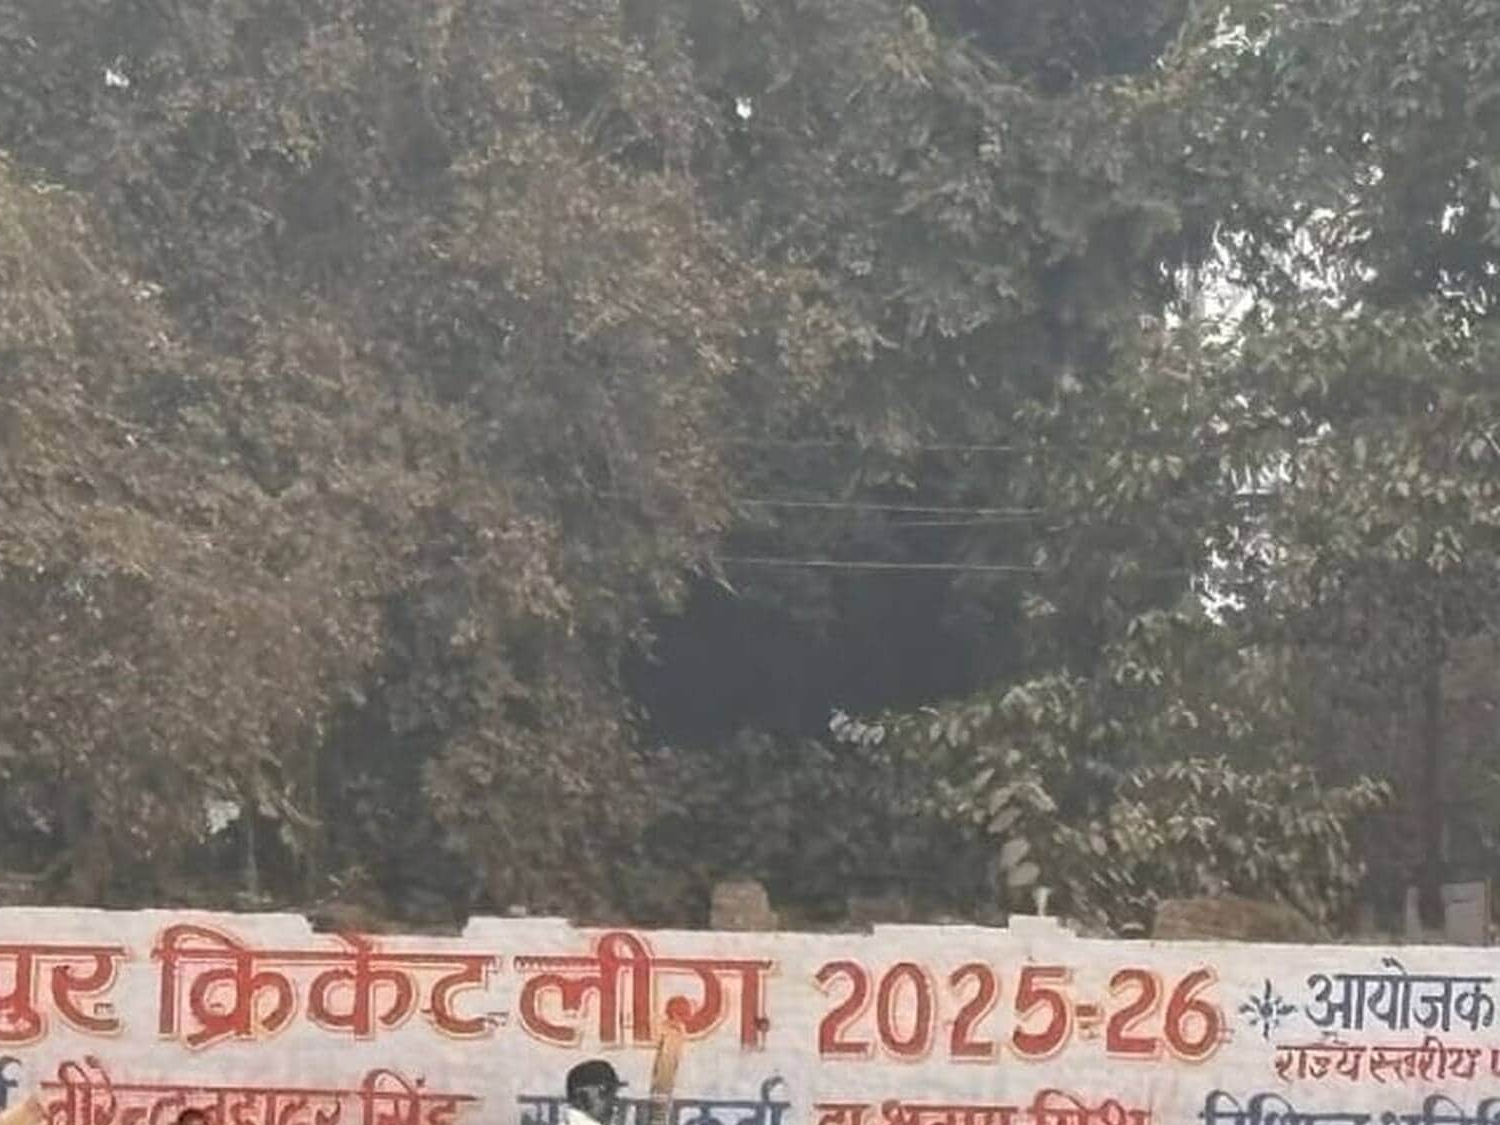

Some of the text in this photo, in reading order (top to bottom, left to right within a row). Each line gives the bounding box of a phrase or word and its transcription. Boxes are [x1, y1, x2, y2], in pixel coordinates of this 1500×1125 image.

[151, 924, 498, 1048] क्रिकेट
[514, 931, 774, 1049] लीग
[813, 960, 1224, 1060] 2025-26
[1306, 957, 1496, 1032] आयोजक
[1274, 1043, 1368, 1082] राज्य
[1370, 1036, 1483, 1082] स्तरीय
